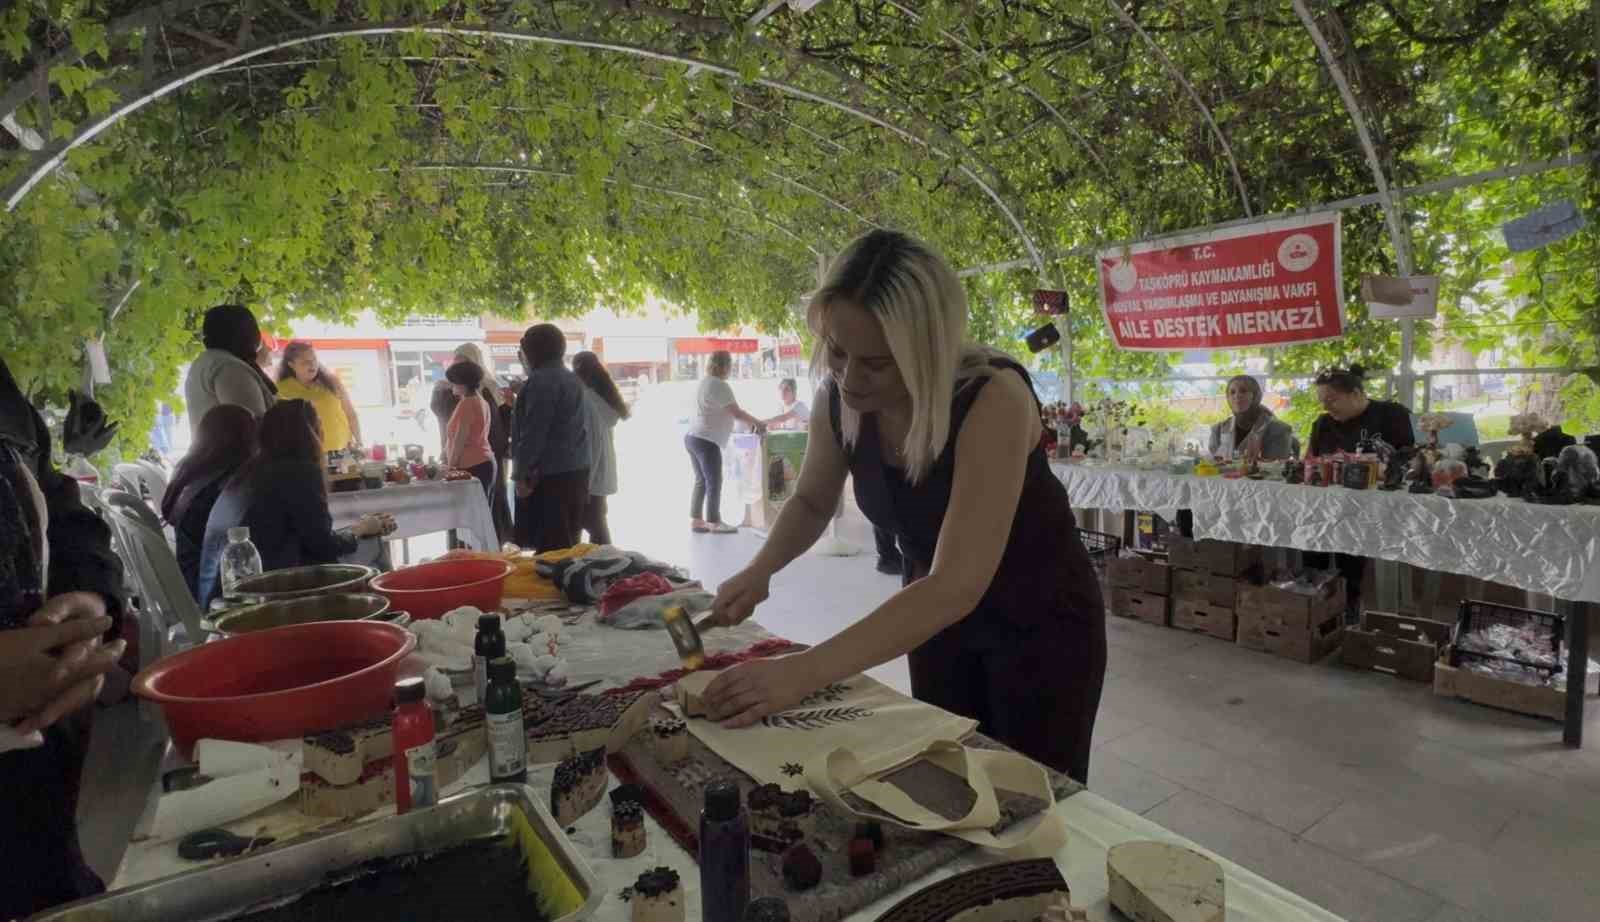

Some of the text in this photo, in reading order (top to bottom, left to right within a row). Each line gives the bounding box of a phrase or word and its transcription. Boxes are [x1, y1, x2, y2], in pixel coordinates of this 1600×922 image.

[1192, 246, 1216, 261] T.C.
[1191, 261, 1275, 287] KAYMAKAMLIĞI
[1206, 293, 1220, 306] VE
[1220, 287, 1281, 305] DAYANIŞMA
[1281, 281, 1317, 299] VAKFI
[1118, 301, 1324, 339] AİLE DESTEK MERKEZİ
